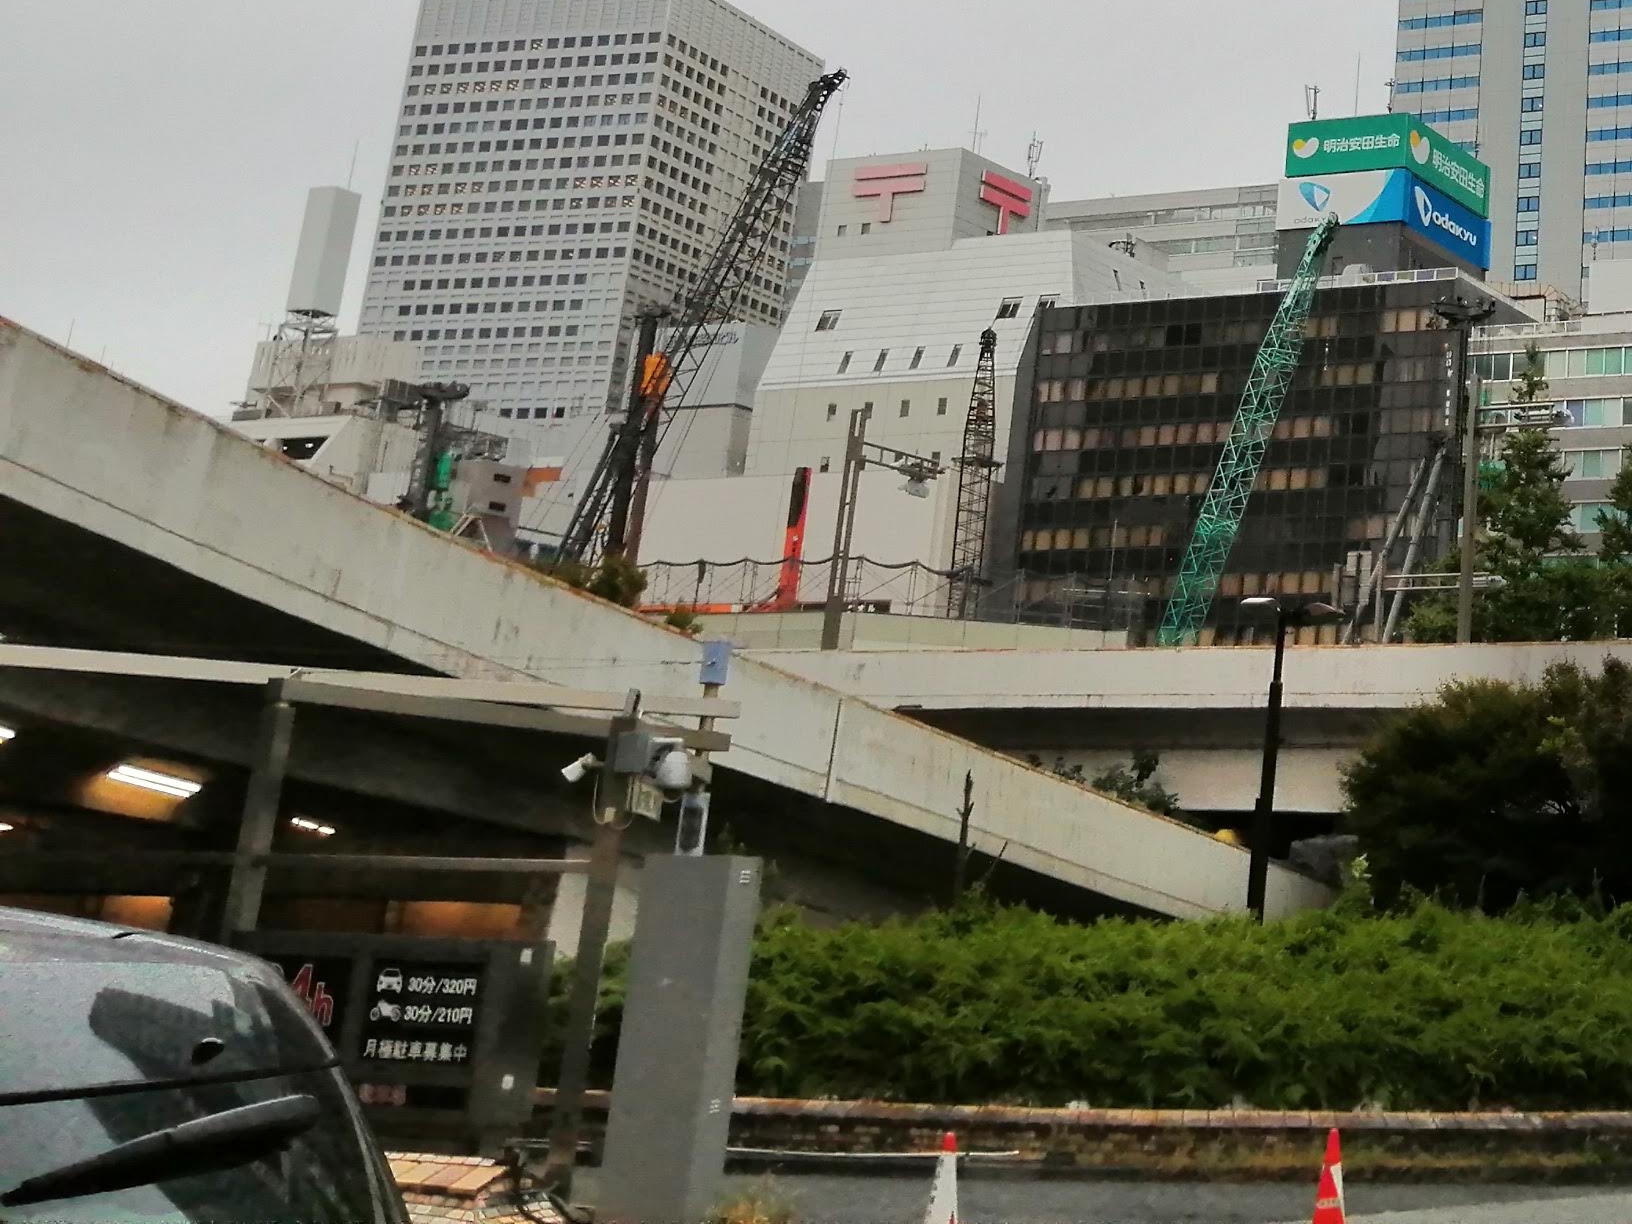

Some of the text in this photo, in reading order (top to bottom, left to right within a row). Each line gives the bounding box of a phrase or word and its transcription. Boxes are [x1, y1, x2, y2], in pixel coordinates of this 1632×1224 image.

[1323, 133, 1400, 153] 明治安田生命
[1432, 148, 1485, 198] 明治安田生命
[1294, 214, 1330, 225] odaky
[1432, 211, 1477, 246] odakyu
[407, 976, 478, 996] 30分/320円
[403, 1004, 473, 1024] 30分/210円
